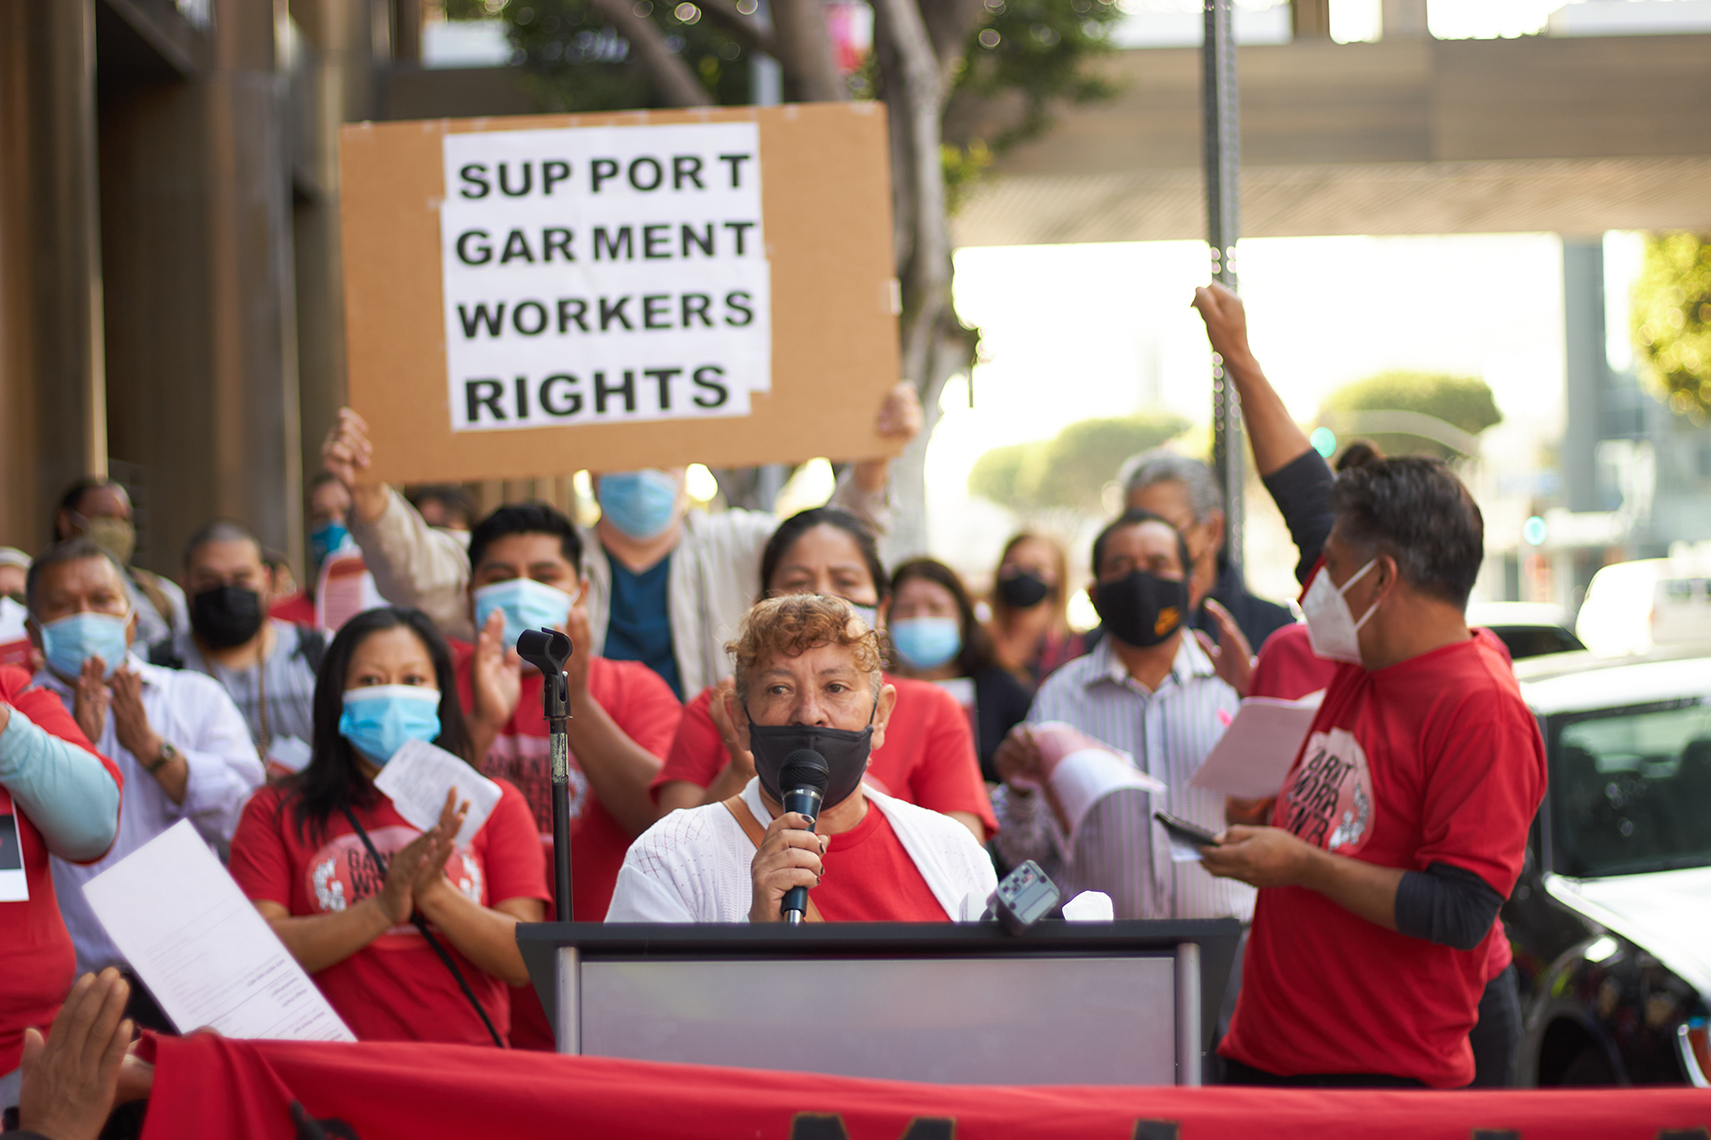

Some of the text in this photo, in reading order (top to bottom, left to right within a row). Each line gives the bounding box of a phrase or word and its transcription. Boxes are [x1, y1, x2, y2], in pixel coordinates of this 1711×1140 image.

[459, 153, 751, 200] SUPPORT
[456, 222, 755, 266] GARMENT
[457, 292, 754, 339] WORKERS
[465, 366, 729, 423] RIGHTS
